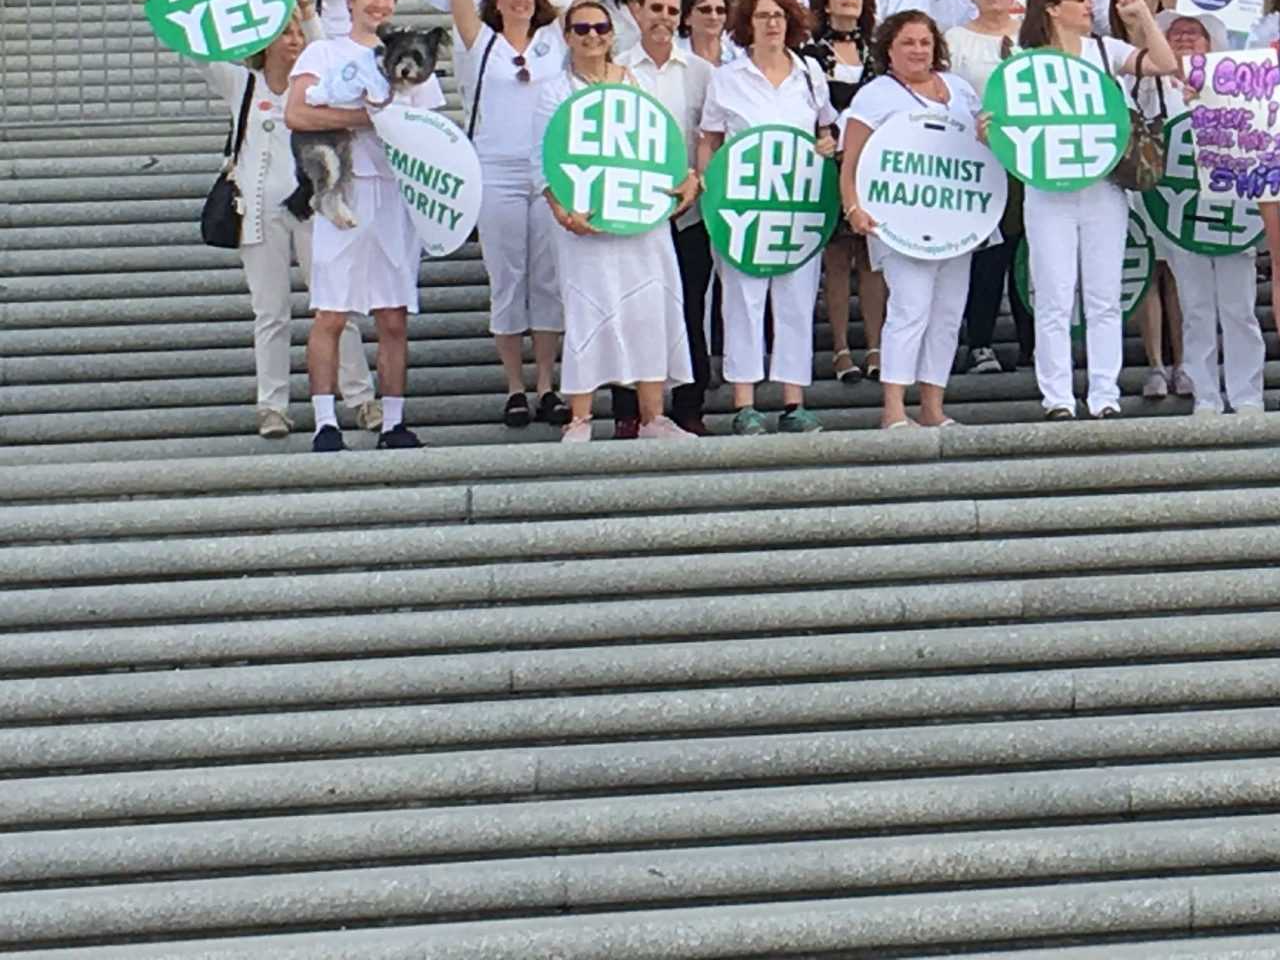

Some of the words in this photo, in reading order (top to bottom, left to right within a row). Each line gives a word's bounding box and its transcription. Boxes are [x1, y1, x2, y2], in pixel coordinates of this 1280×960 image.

[1005, 54, 1106, 117] ERA
[569, 90, 667, 164] ERA
[1001, 124, 1117, 180] YES
[384, 141, 465, 199] EMINIST
[560, 163, 674, 225] YES
[726, 130, 824, 203] ERA
[880, 149, 985, 183] FEMINIST
[399, 178, 464, 231] ORITY
[868, 180, 992, 214] MAJORITY
[1155, 186, 1265, 246] YES
[717, 209, 826, 265] YES
